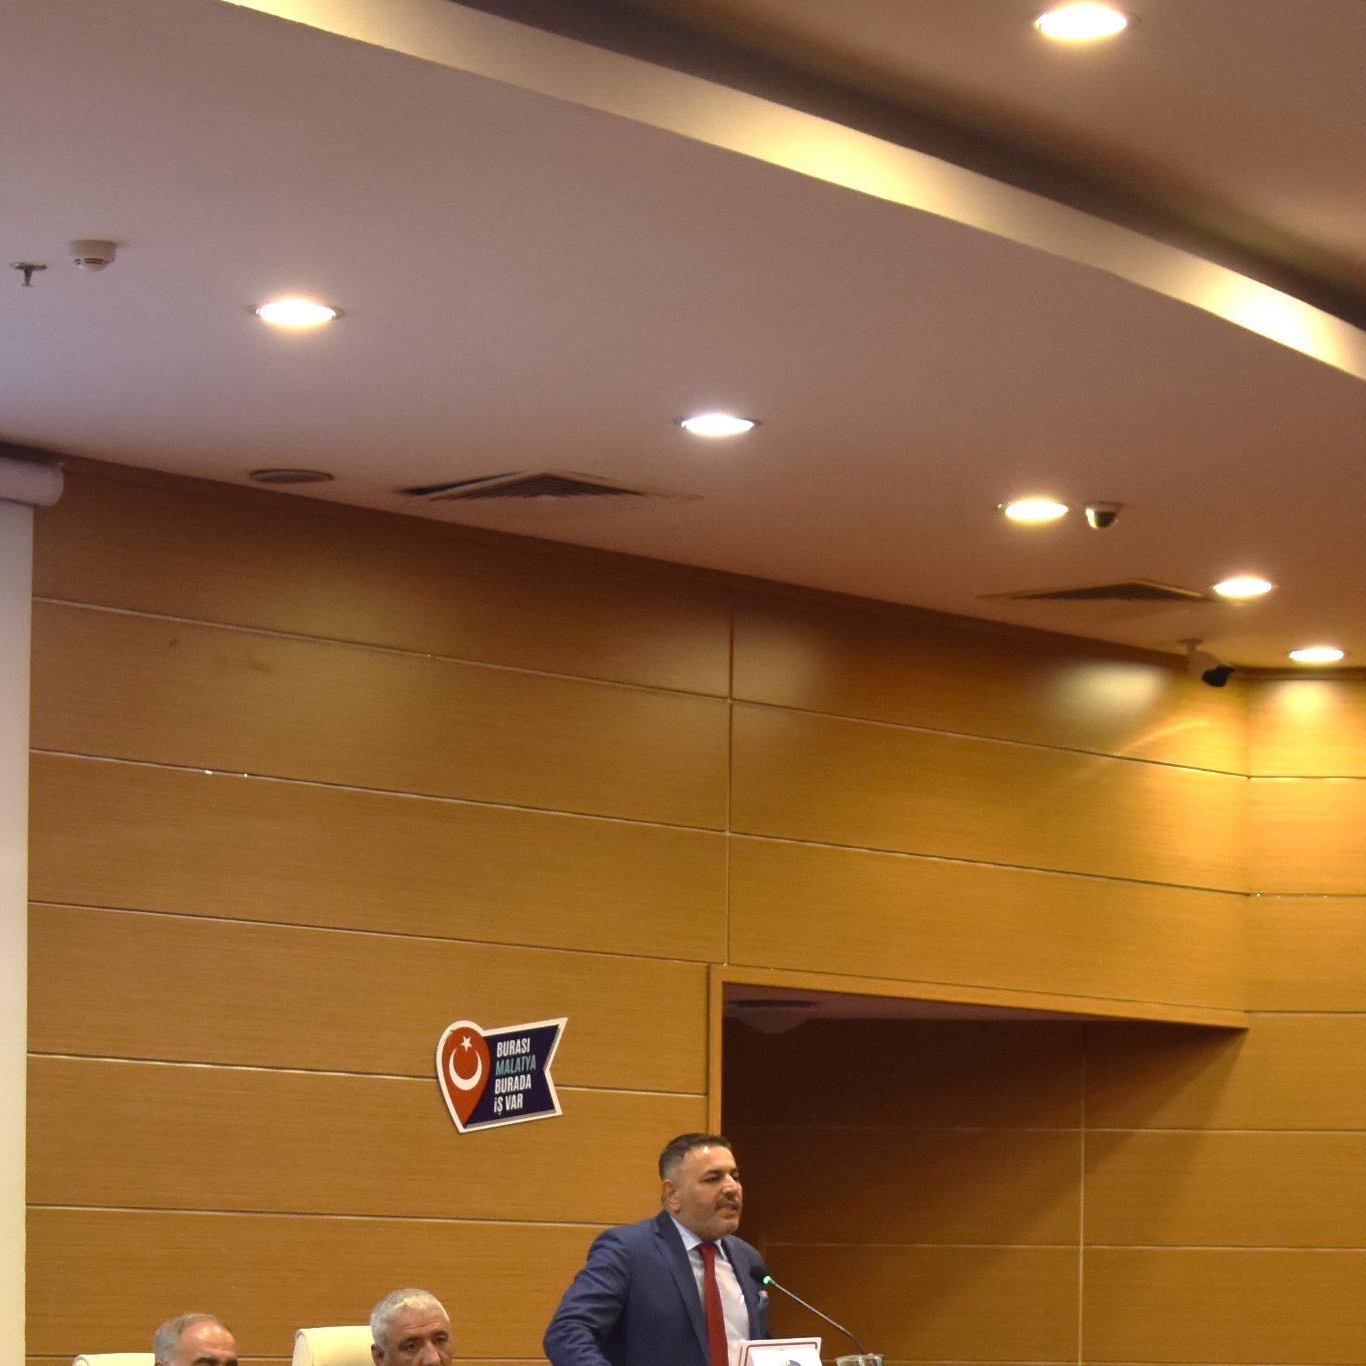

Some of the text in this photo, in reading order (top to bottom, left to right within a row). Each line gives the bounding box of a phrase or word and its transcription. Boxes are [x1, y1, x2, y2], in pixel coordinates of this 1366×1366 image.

[496, 1038, 531, 1057] BURASI
[495, 1055, 536, 1076] MALATYA
[494, 1074, 532, 1095] BURADA
[494, 1094, 524, 1116] İŞ VAR
